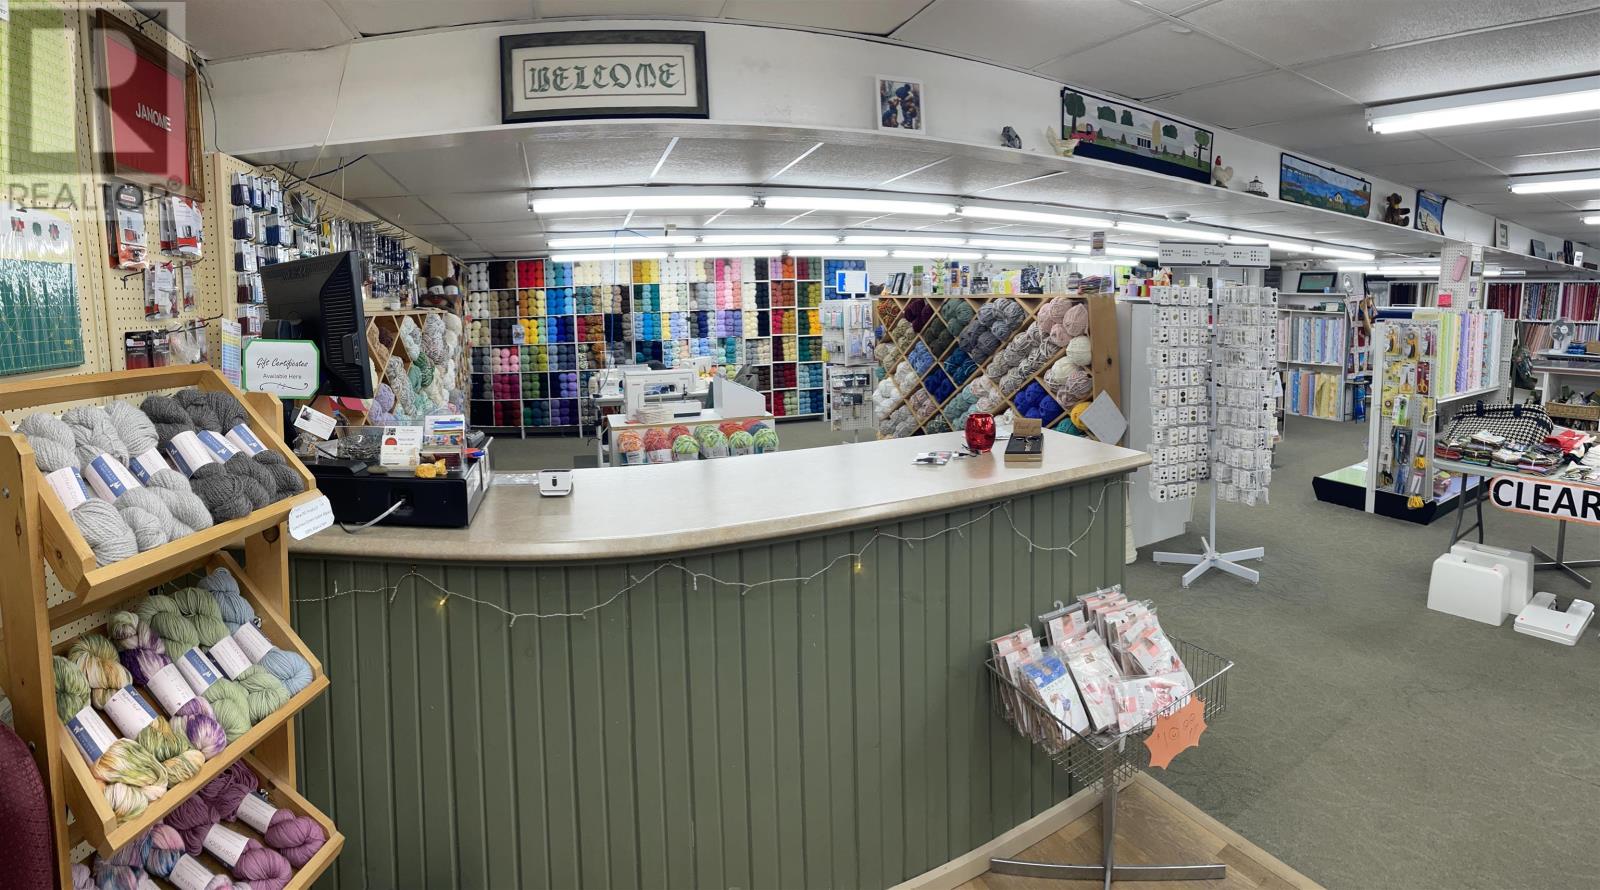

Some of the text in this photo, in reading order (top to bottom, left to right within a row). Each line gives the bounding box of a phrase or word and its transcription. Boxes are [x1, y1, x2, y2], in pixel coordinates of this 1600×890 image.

[529, 62, 681, 93] WELCOME
[135, 102, 172, 131] JANOME
[256, 357, 309, 369] Gift Certificates
[1492, 478, 1600, 521] CLEAR
